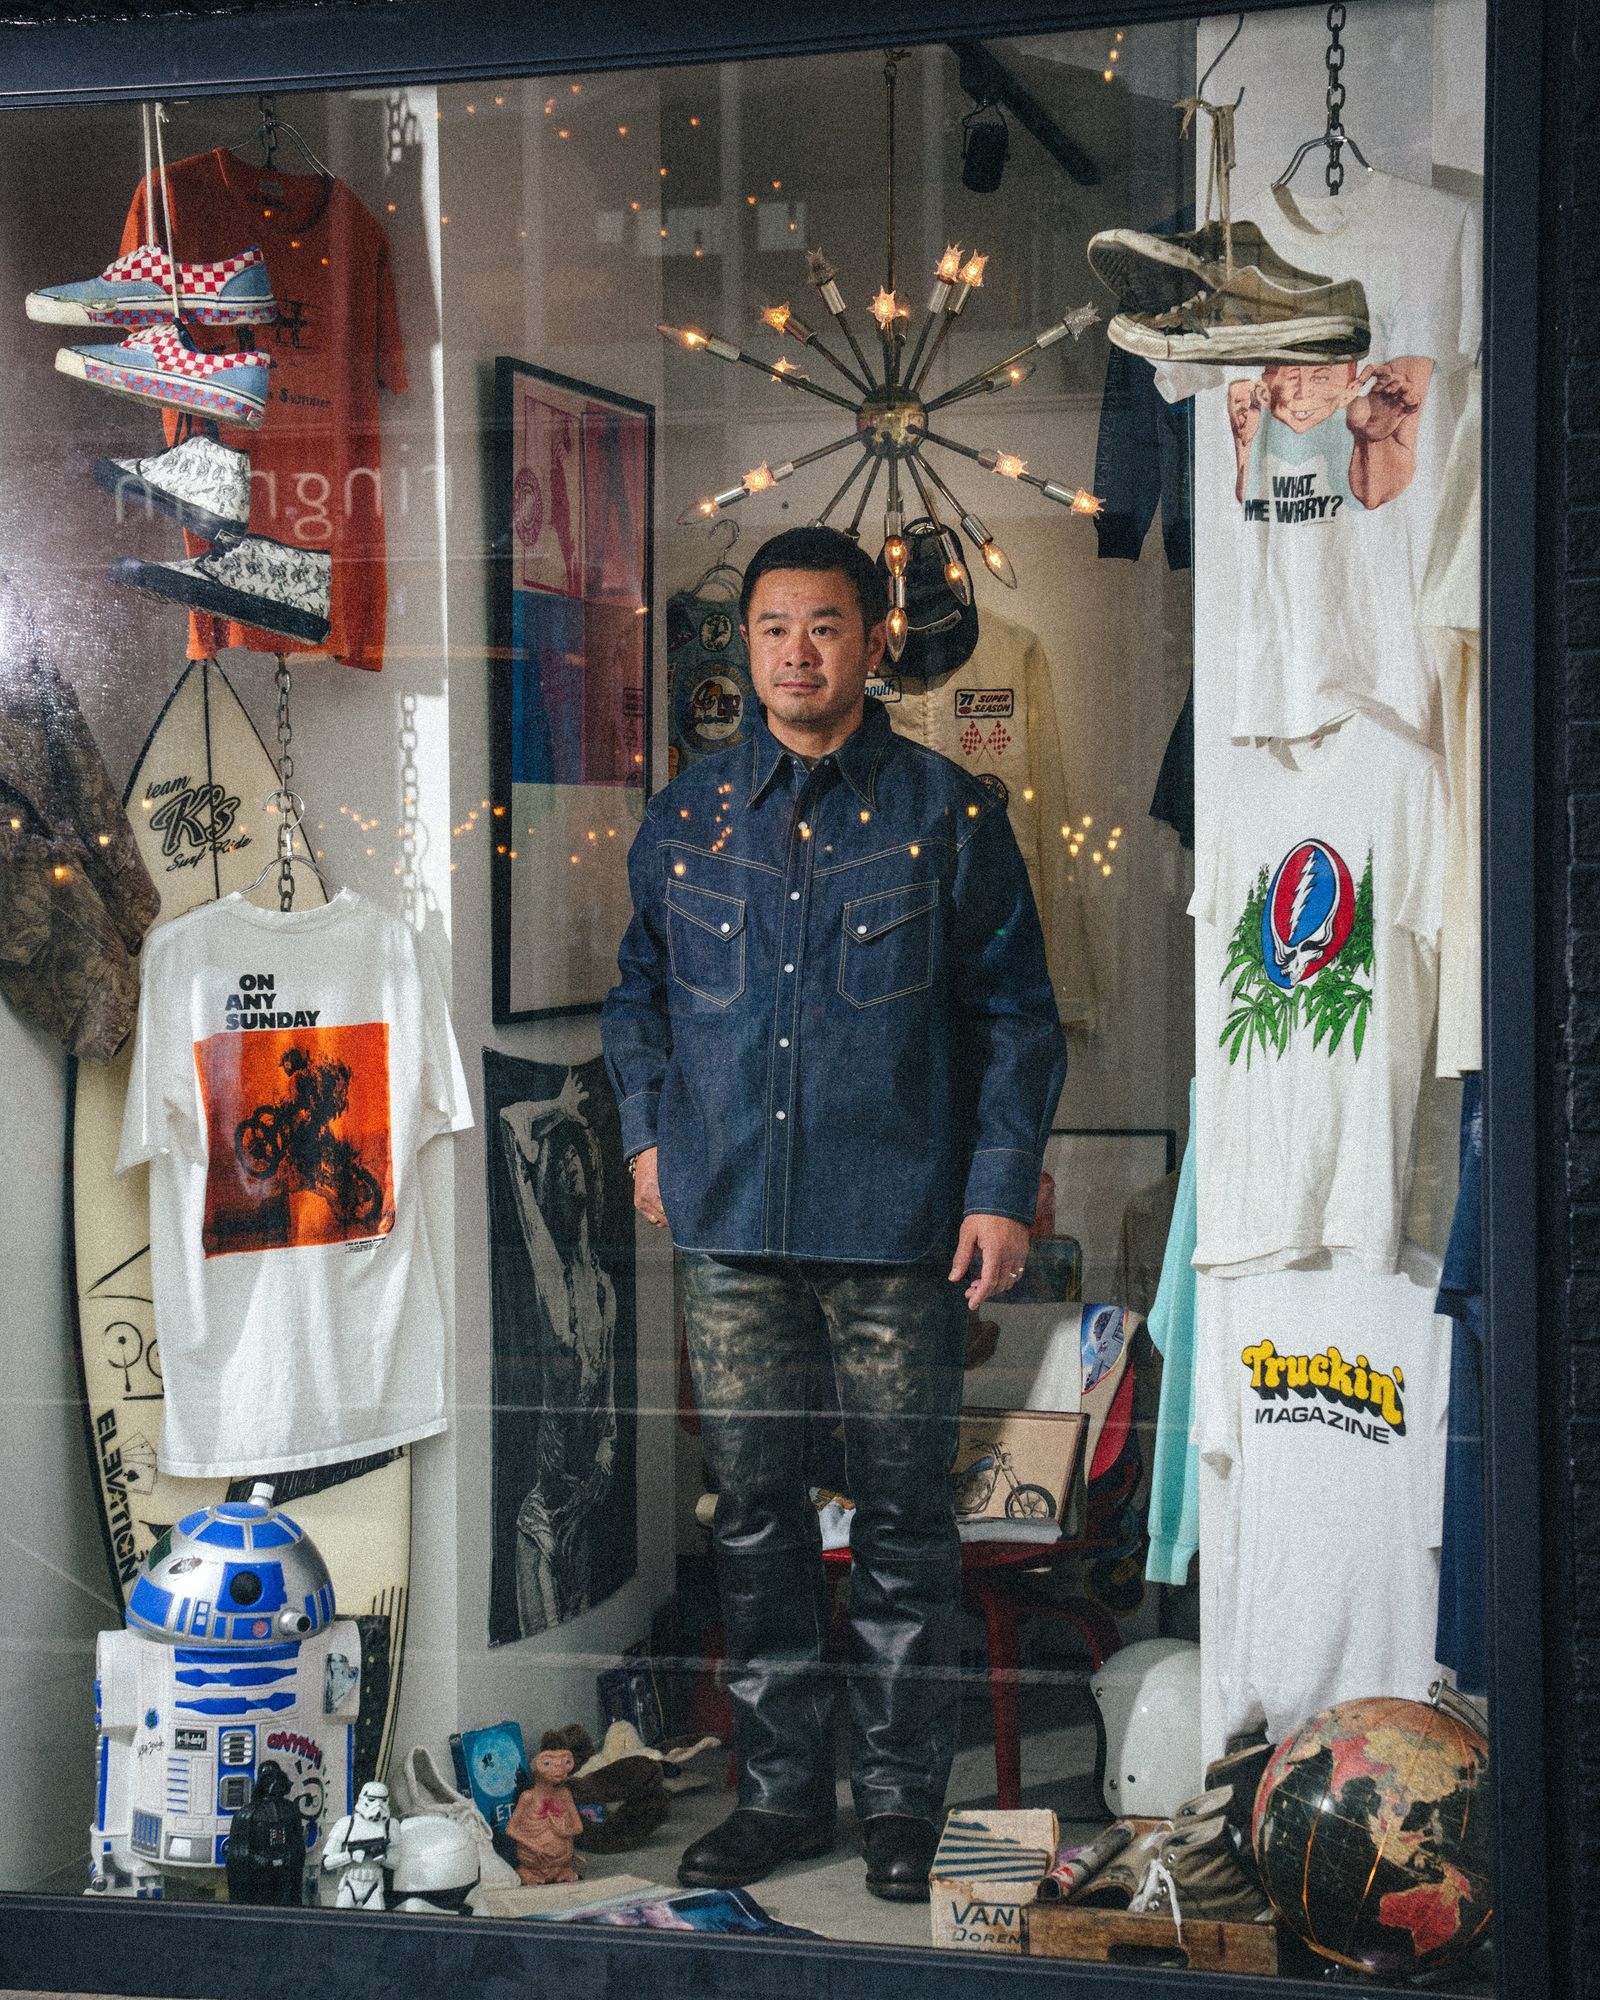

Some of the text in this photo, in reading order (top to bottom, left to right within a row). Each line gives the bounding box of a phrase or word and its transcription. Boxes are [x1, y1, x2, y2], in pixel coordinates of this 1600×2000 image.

[1244, 495, 1344, 523] ME WRRY?
[973, 704, 1011, 713] SEASON
[978, 694, 1010, 703] SUPER
[145, 775, 191, 800] team
[165, 846, 207, 872] Surf
[239, 974, 275, 991] ON
[225, 993, 277, 1011] ANY
[226, 1010, 321, 1031] SUNDAY
[1241, 1338, 1406, 1437] Truckin'
[1255, 1407, 1390, 1444] MAGAZINE
[951, 1900, 1016, 1927] VAN
